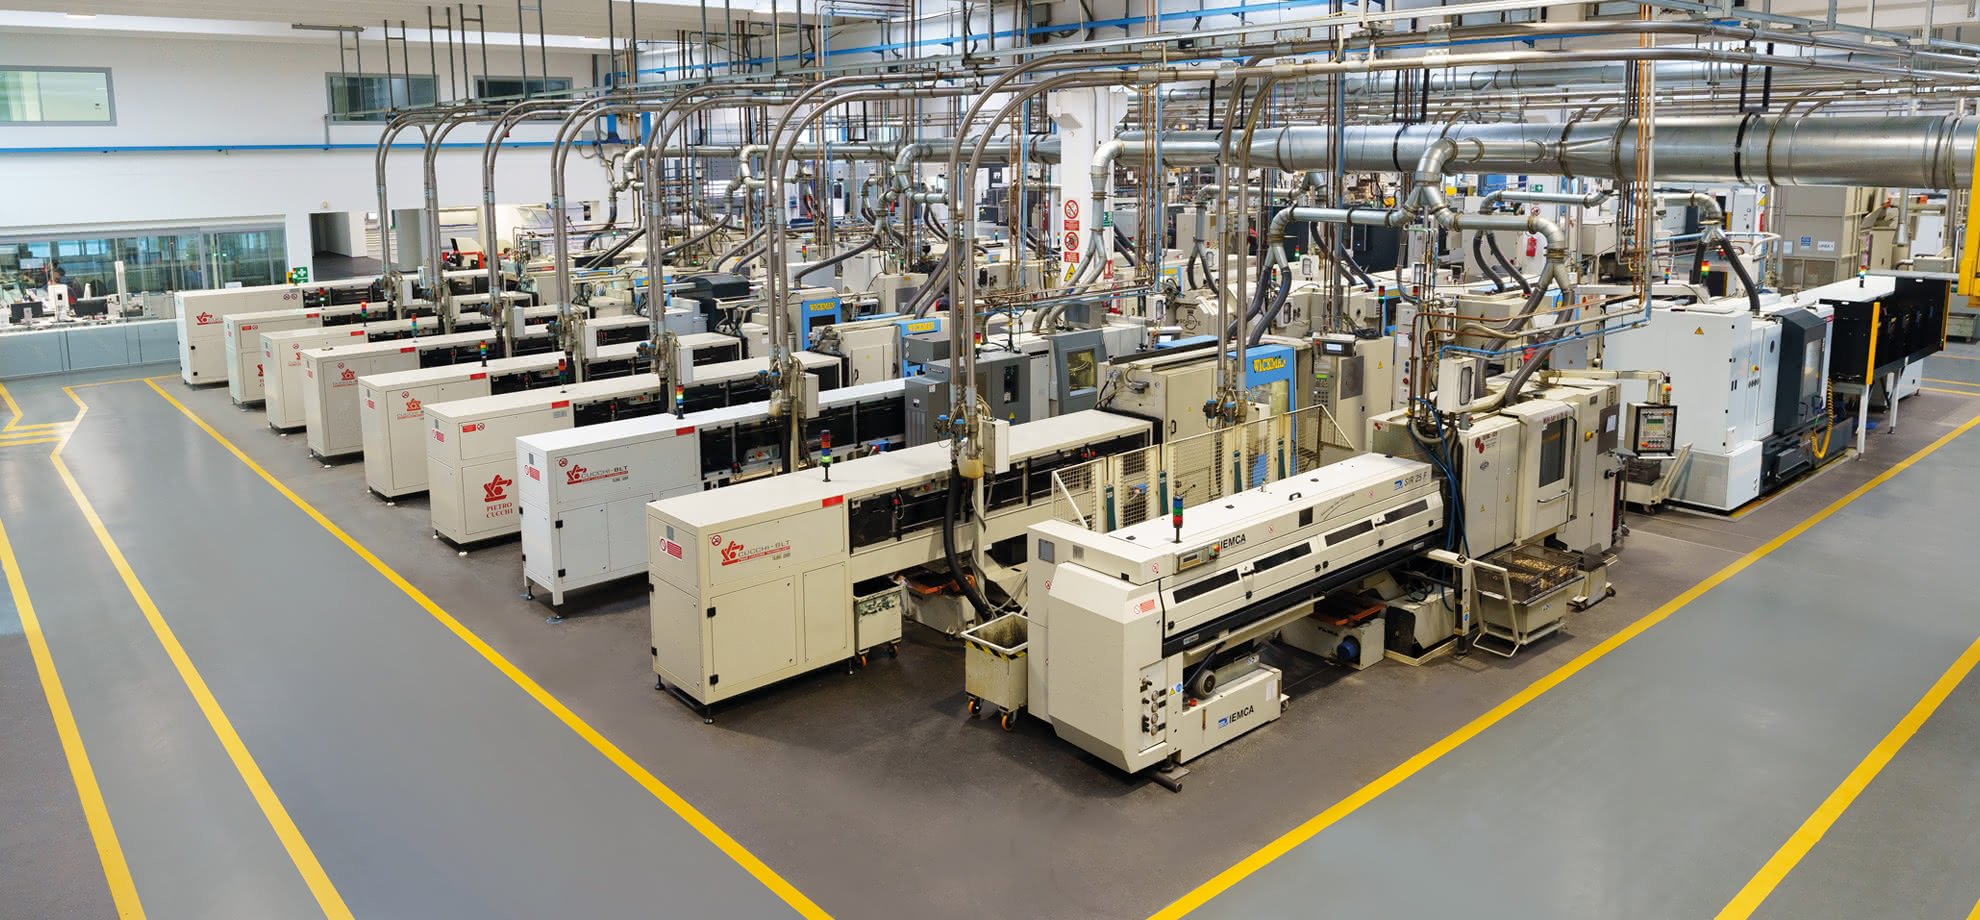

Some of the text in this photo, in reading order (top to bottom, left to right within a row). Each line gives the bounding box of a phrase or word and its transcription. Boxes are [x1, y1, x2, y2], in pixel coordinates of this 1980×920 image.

[486, 502, 513, 512] PIETRO
[486, 508, 513, 519] CUCCHI
[1220, 533, 1247, 549] IEMCA
[1229, 704, 1254, 723] IEMCA
